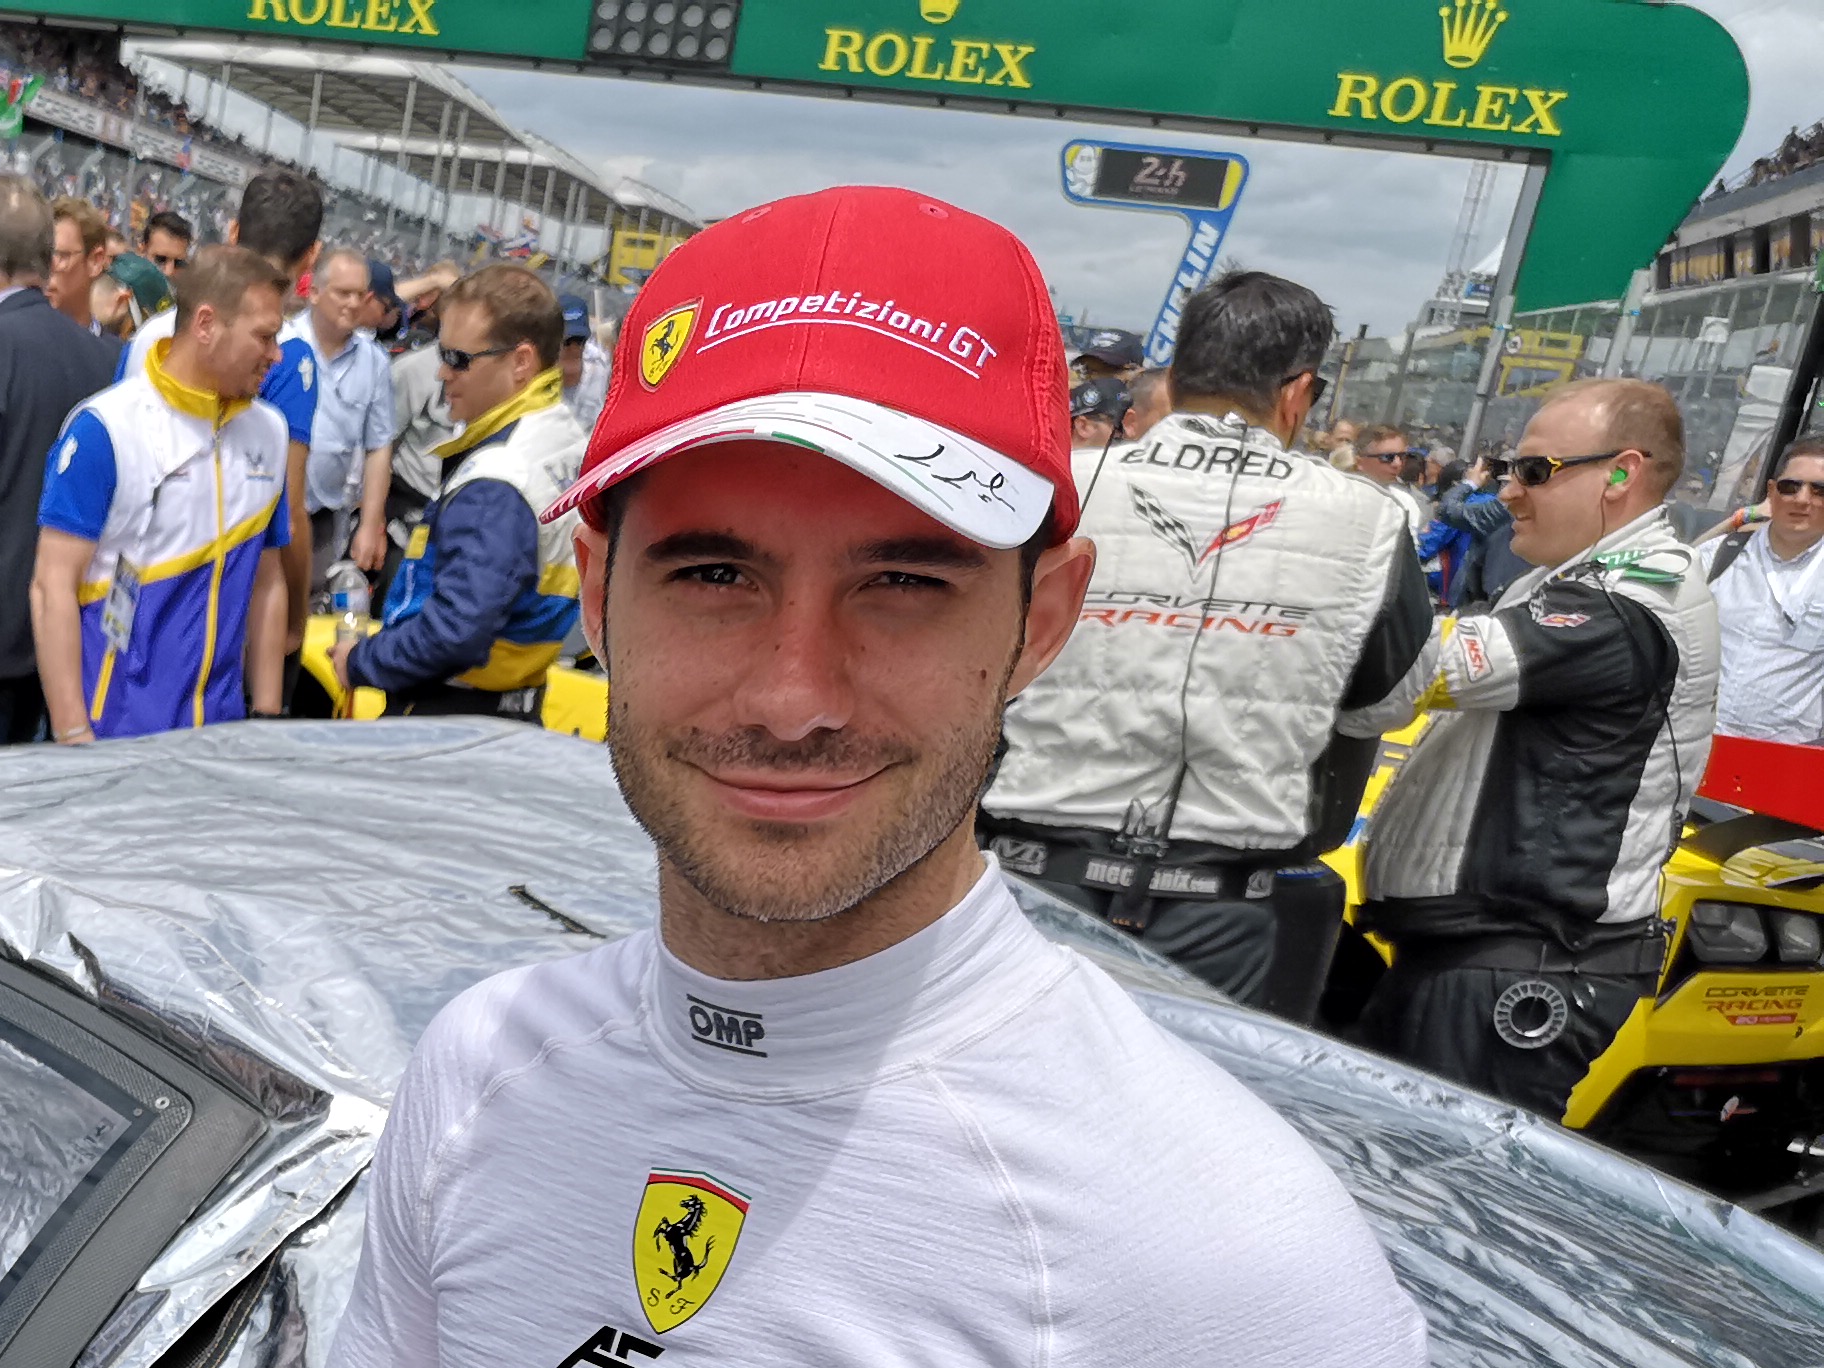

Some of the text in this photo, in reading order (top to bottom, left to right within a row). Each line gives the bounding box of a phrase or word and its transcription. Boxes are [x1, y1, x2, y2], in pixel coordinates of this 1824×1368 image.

[817, 28, 1036, 88] ROLEX
[1327, 72, 1568, 136] ROLEX
[1143, 219, 1220, 368] CHELIN
[705, 290, 997, 369] Competizioni GT
[1079, 609, 1300, 637] RACING
[1705, 985, 1810, 998] CORVETTE
[689, 1005, 765, 1048] OMP
